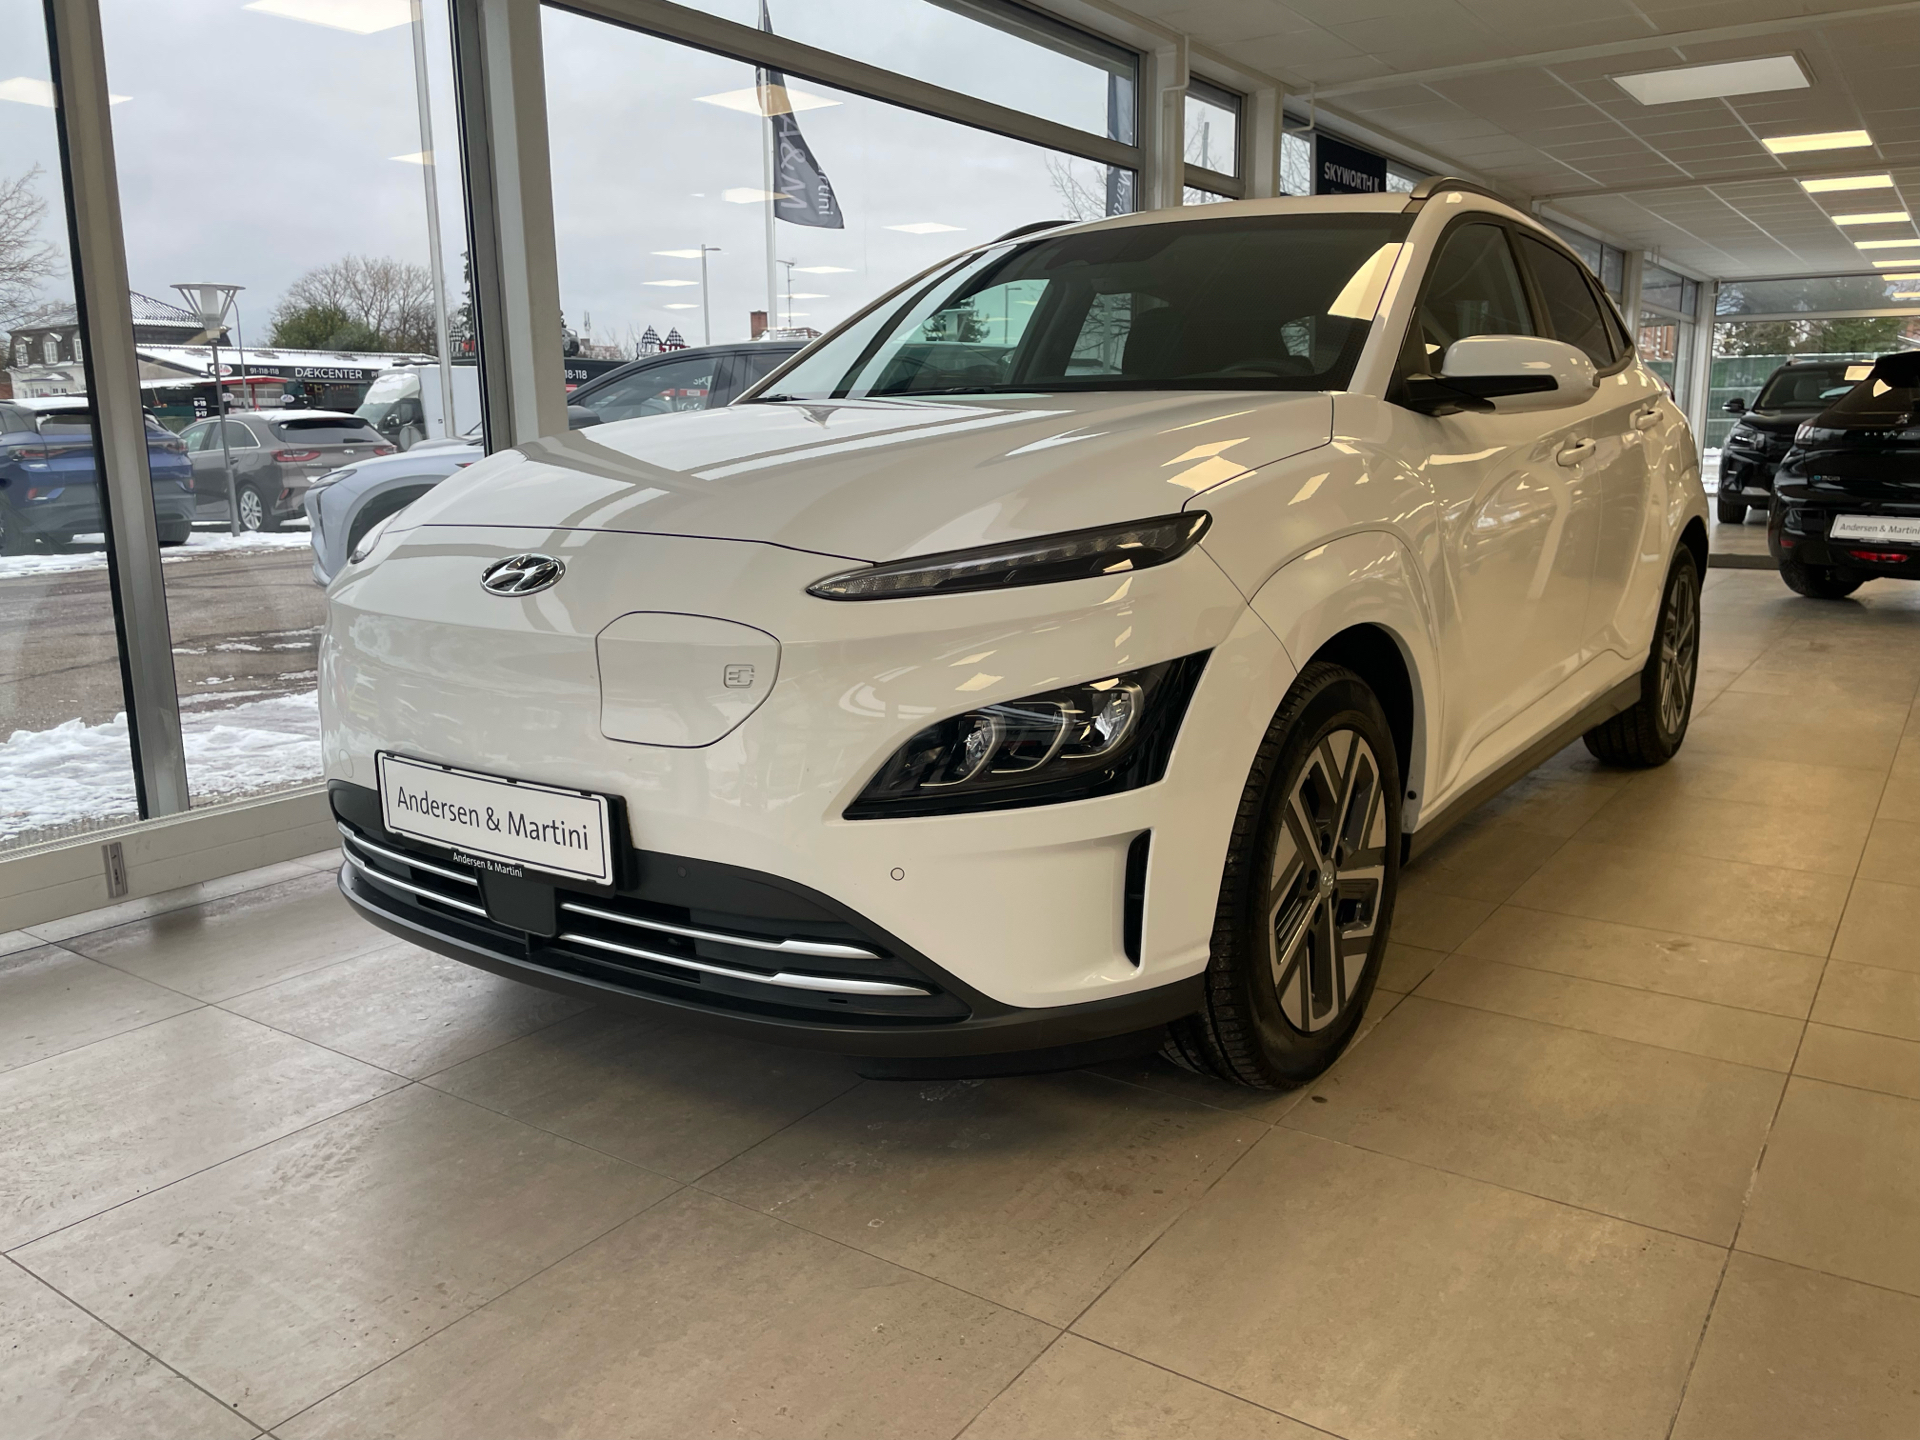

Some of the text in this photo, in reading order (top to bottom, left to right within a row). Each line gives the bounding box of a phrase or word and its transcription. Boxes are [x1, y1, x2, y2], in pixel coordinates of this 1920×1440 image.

[818, 166, 833, 215] rtini
[1324, 162, 1372, 192] SKYWORTH
[295, 367, 363, 379] DÆKCENTER
[1839, 523, 1878, 532] Andersen
[397, 786, 588, 851] Andersen & Martini
[453, 852, 523, 878] Andersen & Martini
